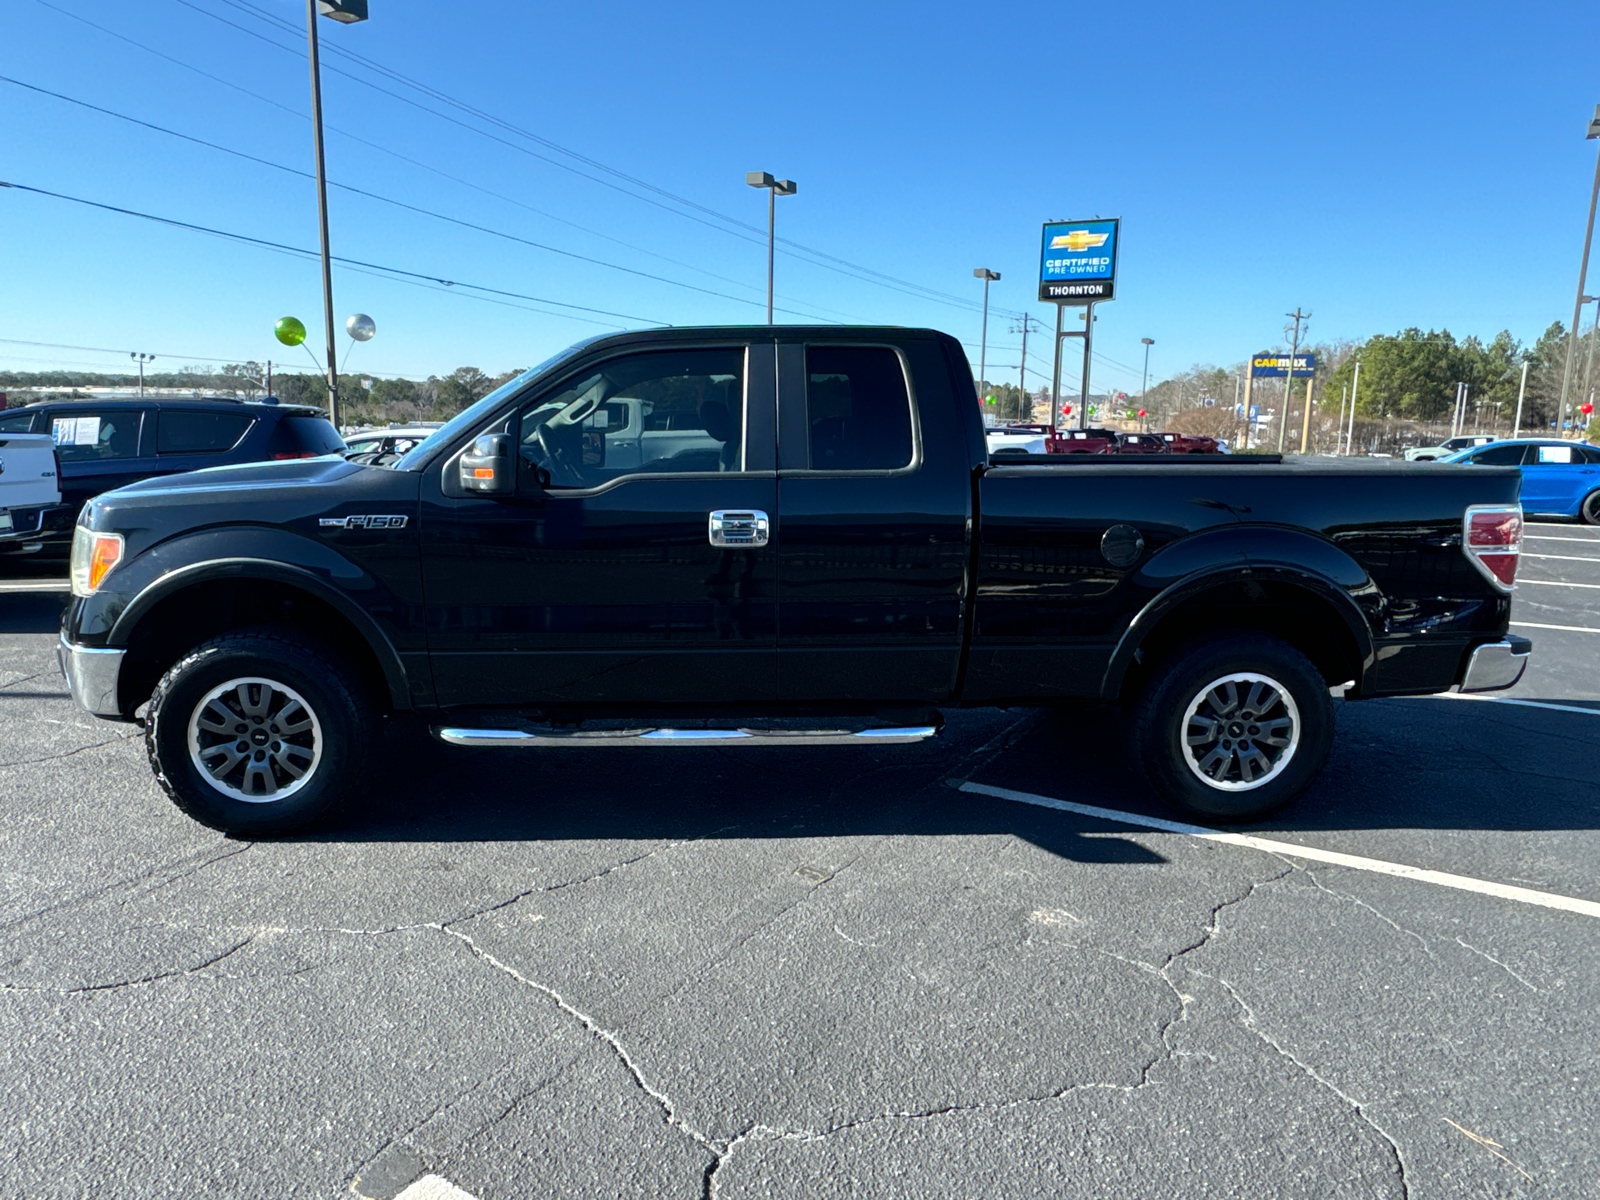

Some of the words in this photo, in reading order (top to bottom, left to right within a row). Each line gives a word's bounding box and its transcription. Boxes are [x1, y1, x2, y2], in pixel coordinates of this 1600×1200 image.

[1046, 257, 1109, 267] CERTIFIED
[1048, 265, 1106, 274] PRE-OWNED
[1049, 285, 1103, 295] THORNTON
